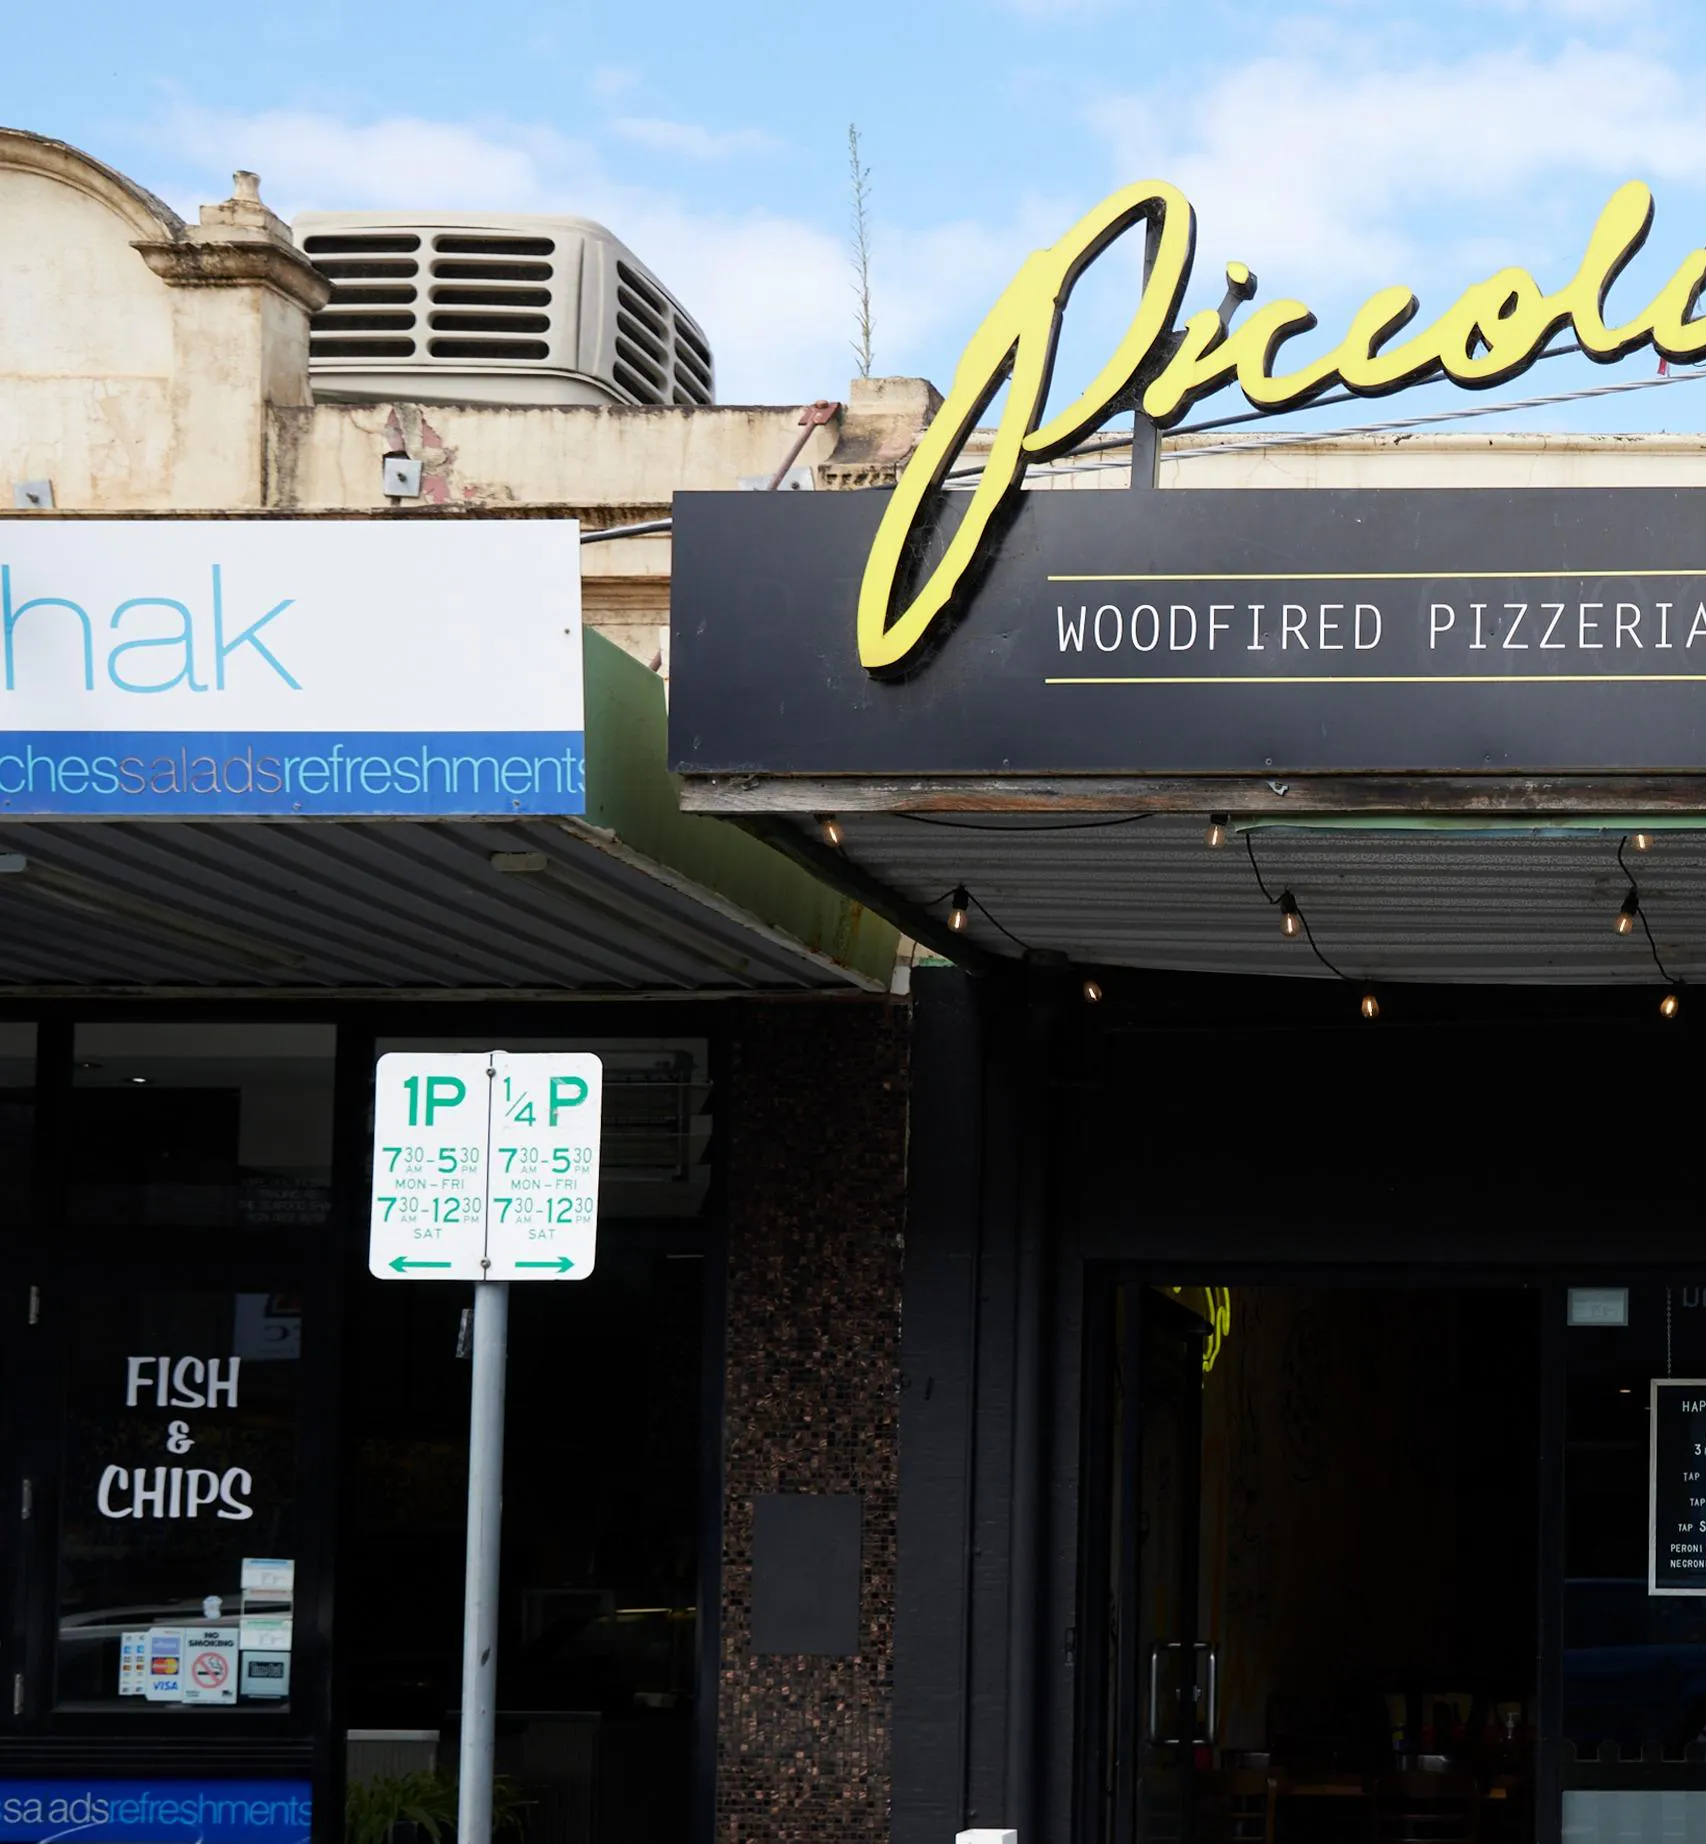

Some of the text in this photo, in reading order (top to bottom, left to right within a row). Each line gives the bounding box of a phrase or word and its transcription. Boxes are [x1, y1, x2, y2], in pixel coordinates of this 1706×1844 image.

[1056, 603, 1383, 653] WOODFIRED
[404, 1075, 466, 1126] 1P
[549, 1076, 588, 1126] P
[413, 1228, 442, 1239] SAT
[528, 1228, 556, 1240] SAT
[126, 1355, 242, 1409] FISH
[166, 1420, 196, 1454] &
[1683, 1472, 1700, 1482] TAP
[97, 1464, 254, 1520] CHIPS
[1690, 1497, 1706, 1507] TAP
[1678, 1523, 1693, 1533] TAP
[1670, 1544, 1703, 1553] PERONI
[204, 1631, 219, 1639] NO
[188, 1639, 235, 1648] SMOKING
[153, 1680, 178, 1691] VISA
